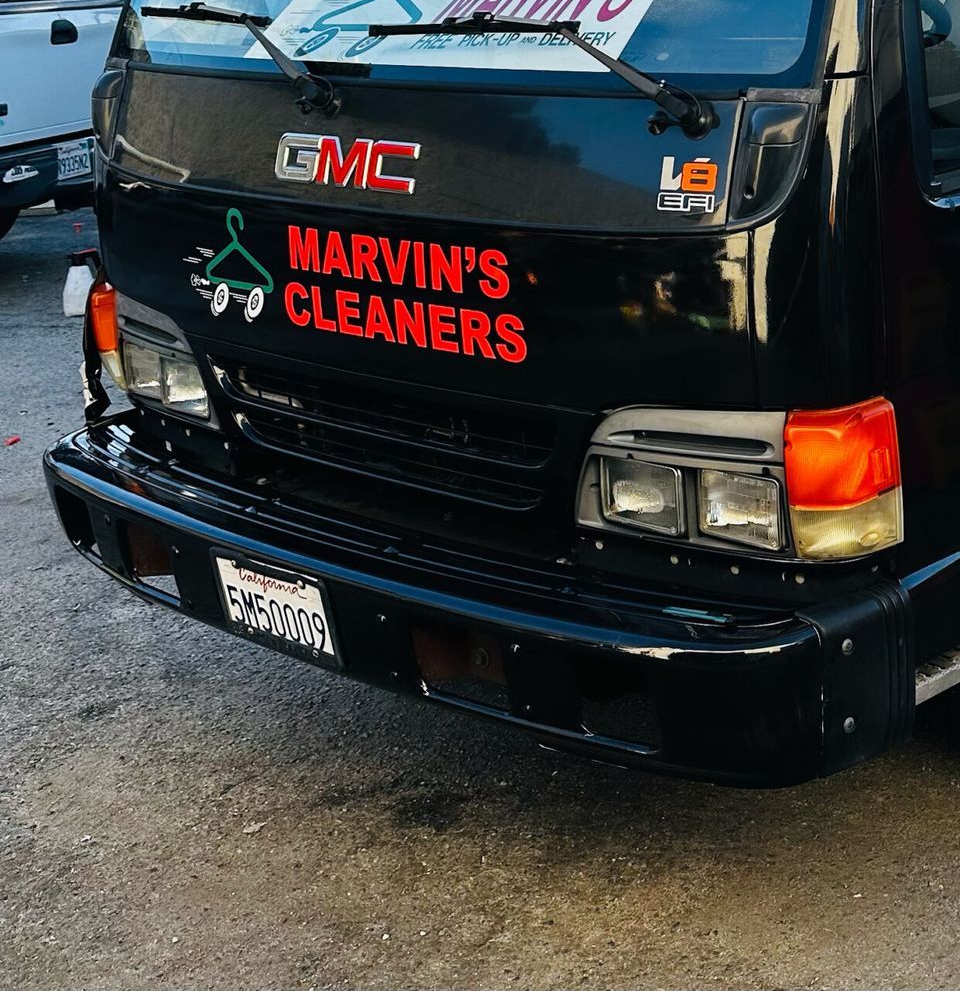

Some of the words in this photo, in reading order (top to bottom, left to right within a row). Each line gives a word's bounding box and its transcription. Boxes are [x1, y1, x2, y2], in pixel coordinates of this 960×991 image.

[410, 33, 452, 50] FREE
[457, 32, 520, 47] PICK-UP
[521, 36, 535, 44] AND
[275, 132, 422, 195] GMC
[657, 192, 715, 213] EFI
[288, 225, 510, 299] MARVIN'S
[284, 281, 528, 363] CLEANERS
[226, 584, 325, 650] 5M50009
